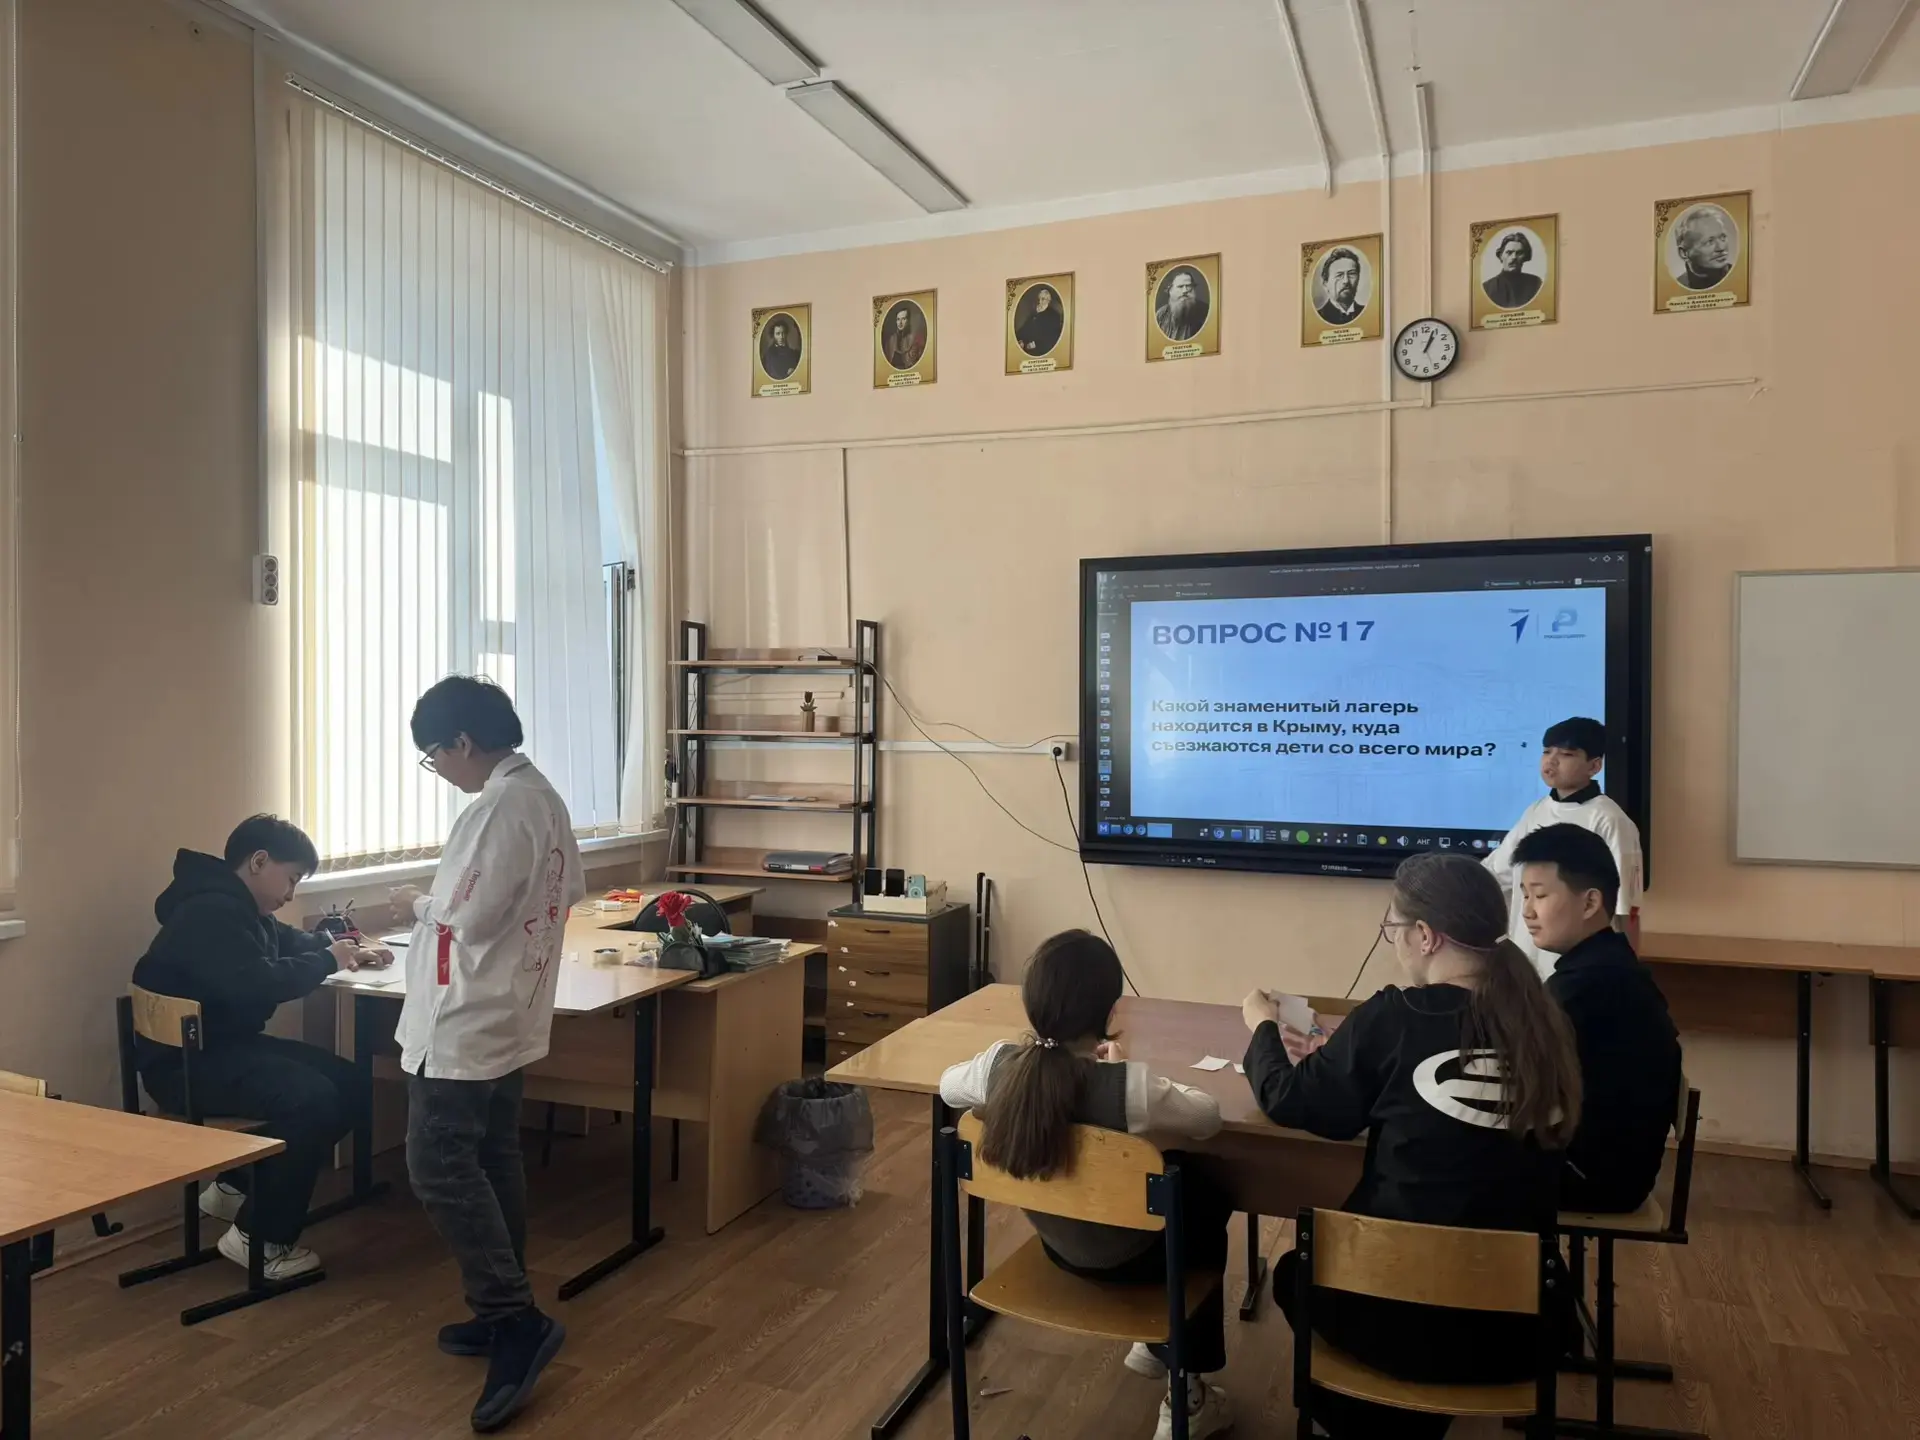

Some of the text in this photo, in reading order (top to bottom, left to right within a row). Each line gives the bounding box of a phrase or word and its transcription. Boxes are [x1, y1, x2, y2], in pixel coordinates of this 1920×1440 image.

[1152, 622, 1287, 645] ВОПРОС
[1151, 698, 1419, 717] Какой знаменитый лагерь
[1151, 719, 1400, 737] находится в Крыму, куда
[1151, 740, 1496, 759] съезжаются дети со всего мира?
